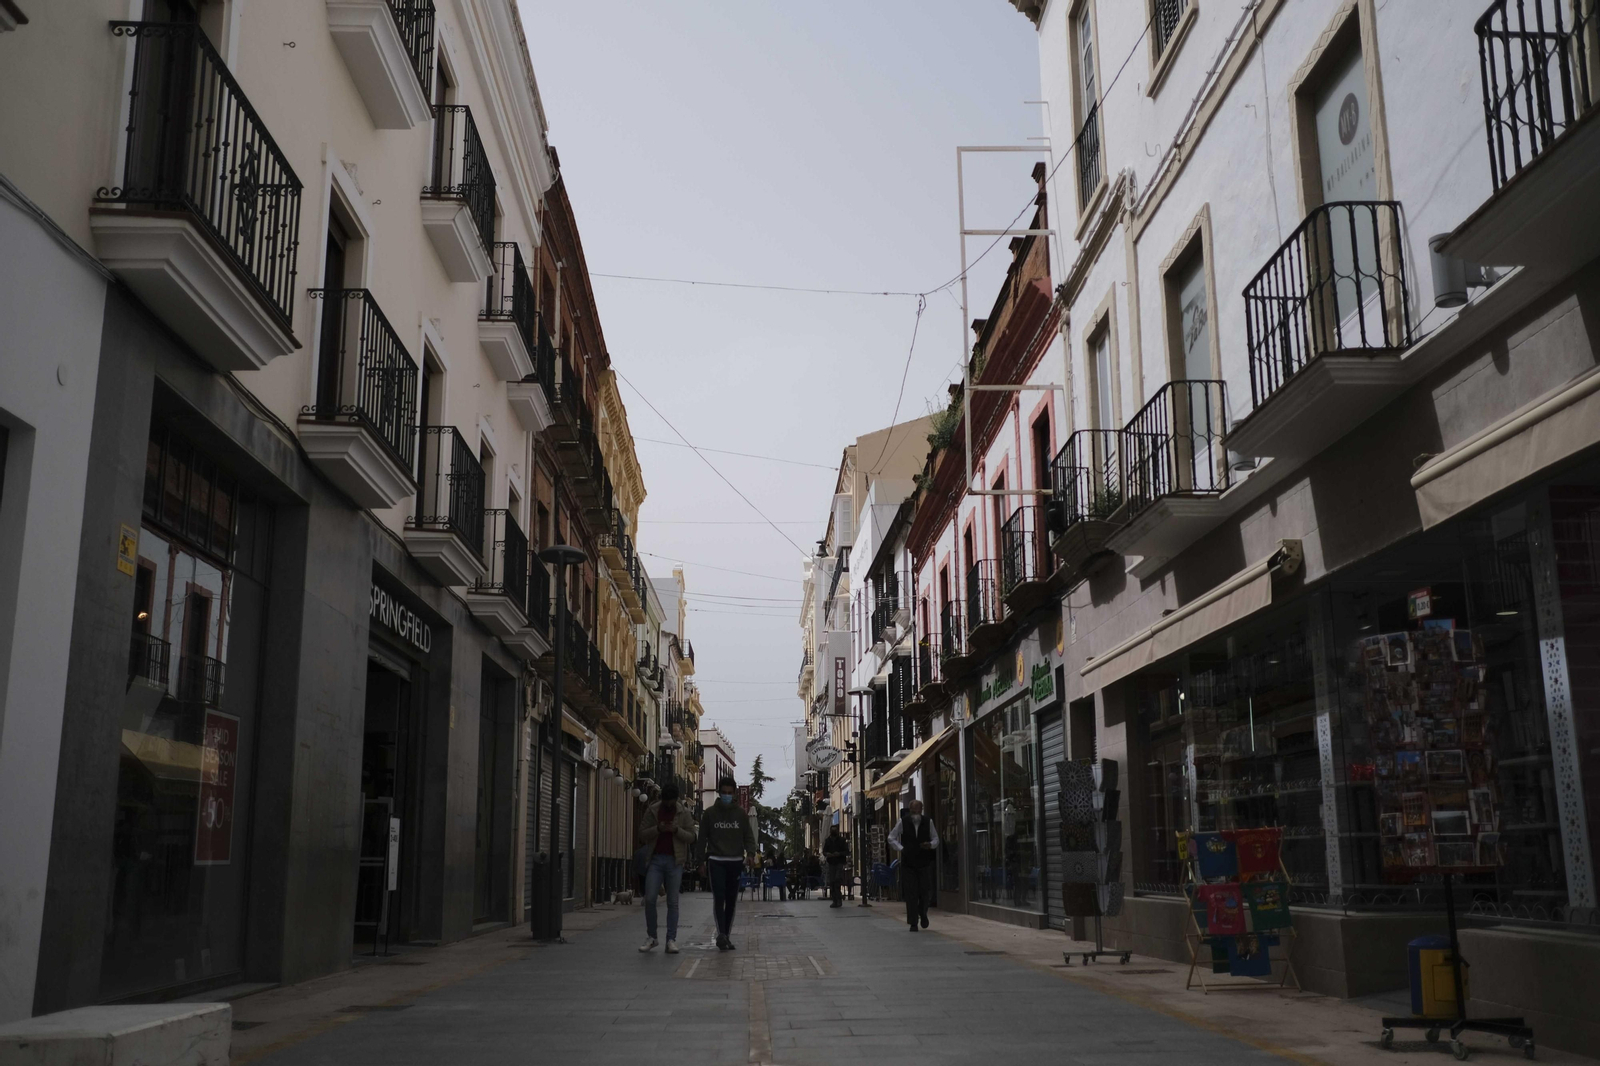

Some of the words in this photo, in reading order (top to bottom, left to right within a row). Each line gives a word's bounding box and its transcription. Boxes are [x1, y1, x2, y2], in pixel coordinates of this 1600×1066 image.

[836, 659, 844, 698] TORO
[214, 728, 229, 745] MID
[205, 748, 235, 767] SEASON
[209, 770, 228, 786] SALE
